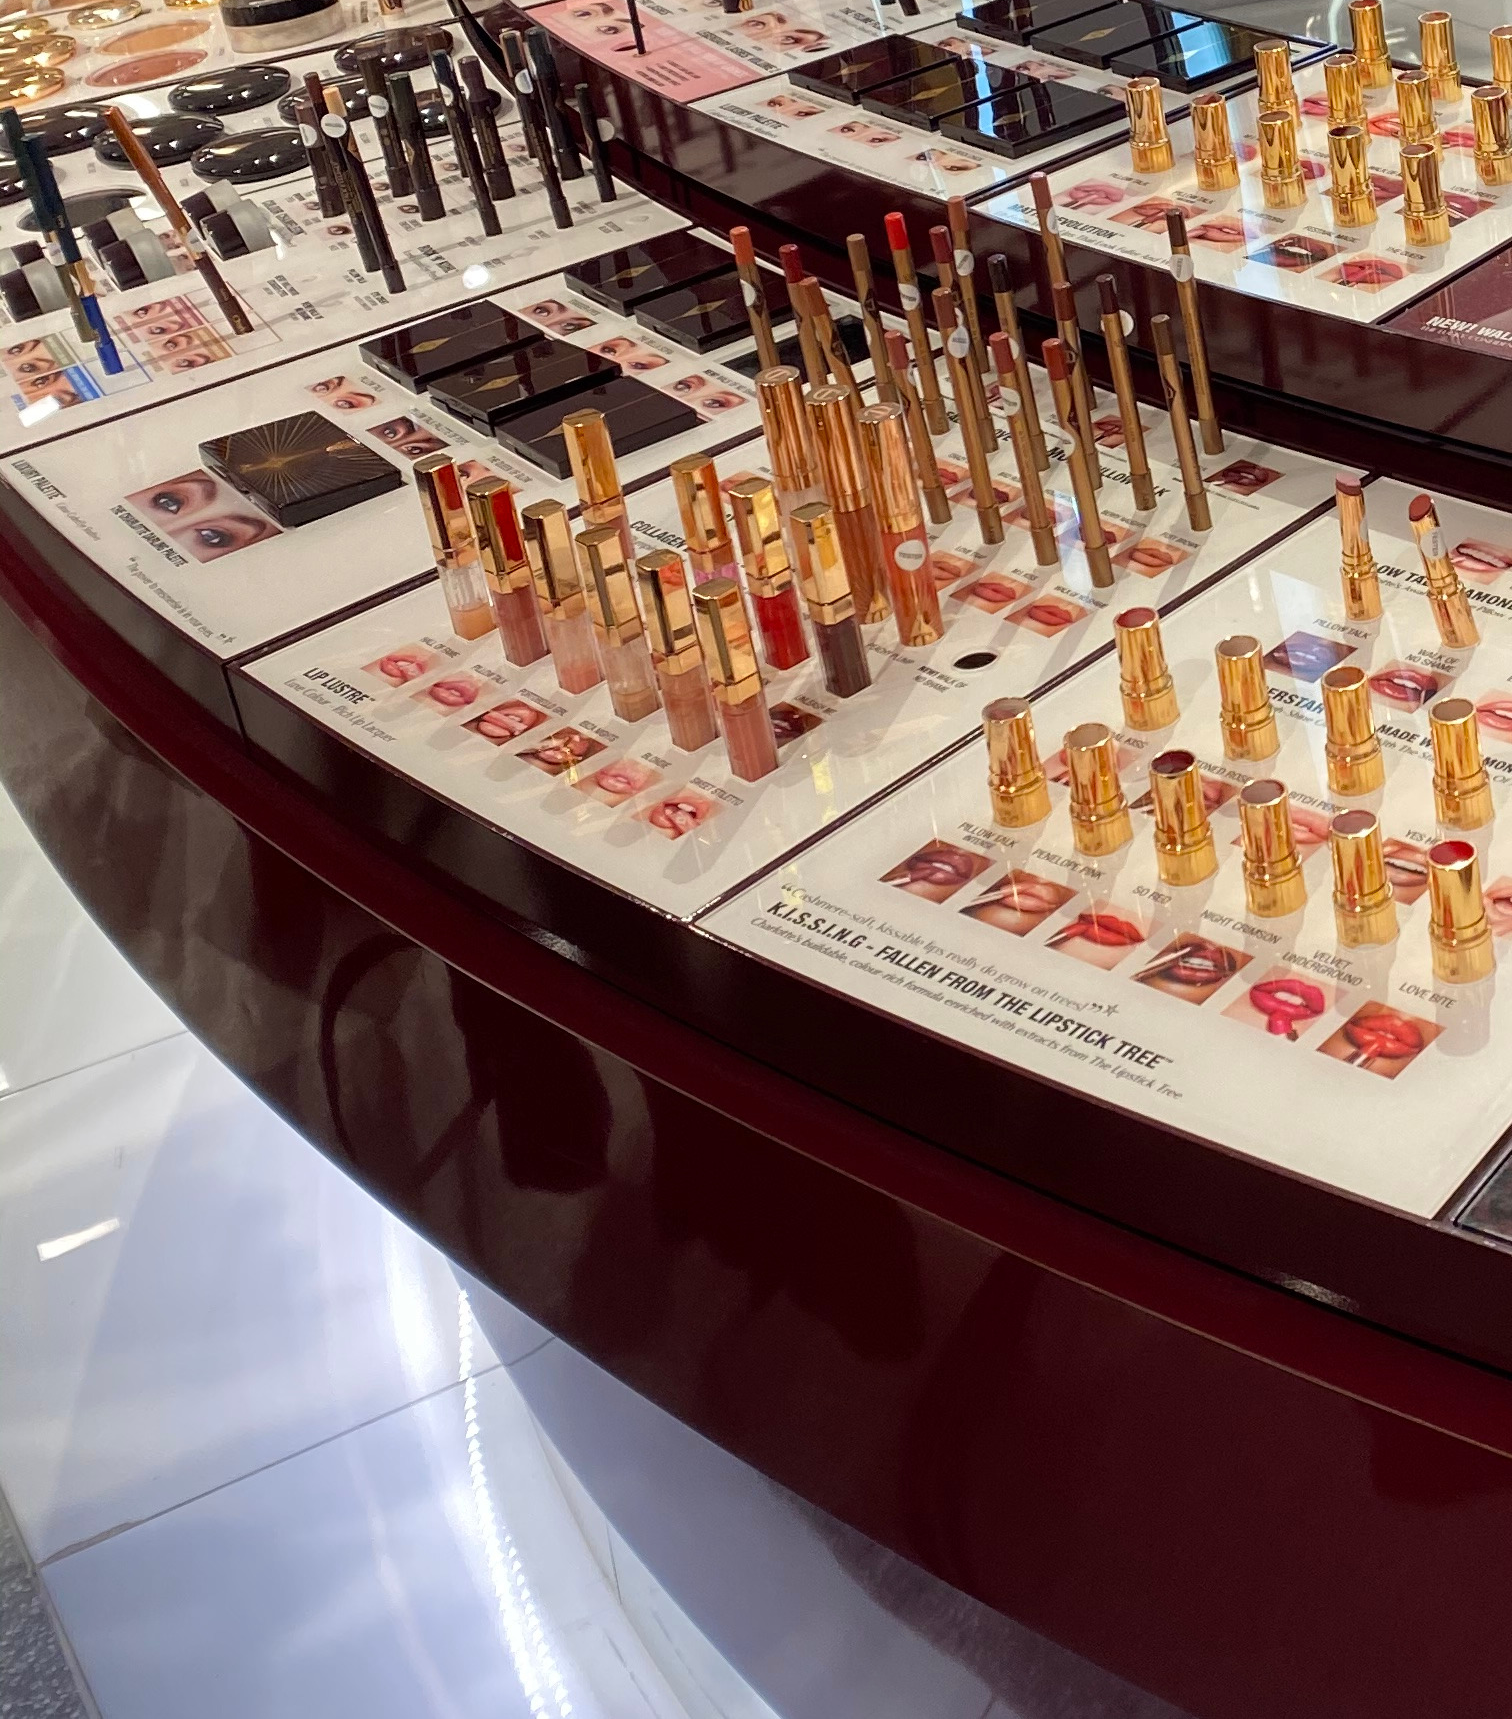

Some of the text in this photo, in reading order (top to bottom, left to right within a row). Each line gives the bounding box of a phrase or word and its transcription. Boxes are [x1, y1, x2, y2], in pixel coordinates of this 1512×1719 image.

[1108, 172, 1131, 184] PILLOW
[1174, 190, 1195, 200] PILLOW
[1425, 316, 1474, 332] NEW!
[630, 519, 687, 550] COLLAGEN
[1313, 618, 1372, 639] PILLOW TALK
[1405, 653, 1456, 674] NO SHAME
[1418, 648, 1444, 662] WALK
[303, 667, 371, 705] LIP LUSTRE
[1377, 723, 1420, 745] MADE
[1288, 790, 1319, 807] BITCH
[958, 821, 1018, 849] PILLOW TALK
[1406, 829, 1426, 842] YES
[1032, 847, 1107, 881] PENELOPE PINK
[1132, 885, 1172, 905] SO RED
[1200, 908, 1284, 946] NIGHT CRIMSON
[876, 919, 1050, 997] kissable lips really do grow on
[1282, 951, 1364, 987] UNDERGROUND
[1313, 948, 1354, 971] VELVET
[766, 901, 1168, 1070] K.I.S.S.I.N.G FALLEN FROM THE LIPSTICK TREE
[1398, 981, 1457, 1010] LOVE BITE
[750, 916, 803, 943] Charlotte's
[848, 958, 904, 987] colour-rich
[901, 977, 946, 1004] formula
[944, 995, 993, 1024] enriched
[990, 1014, 1016, 1032] with
[1014, 1025, 1060, 1050] extracts
[1058, 1042, 1090, 1063] from
[1088, 1055, 1113, 1071] The
[1108, 1061, 1161, 1089] Lipstick
[1156, 1082, 1184, 1101] Tree
